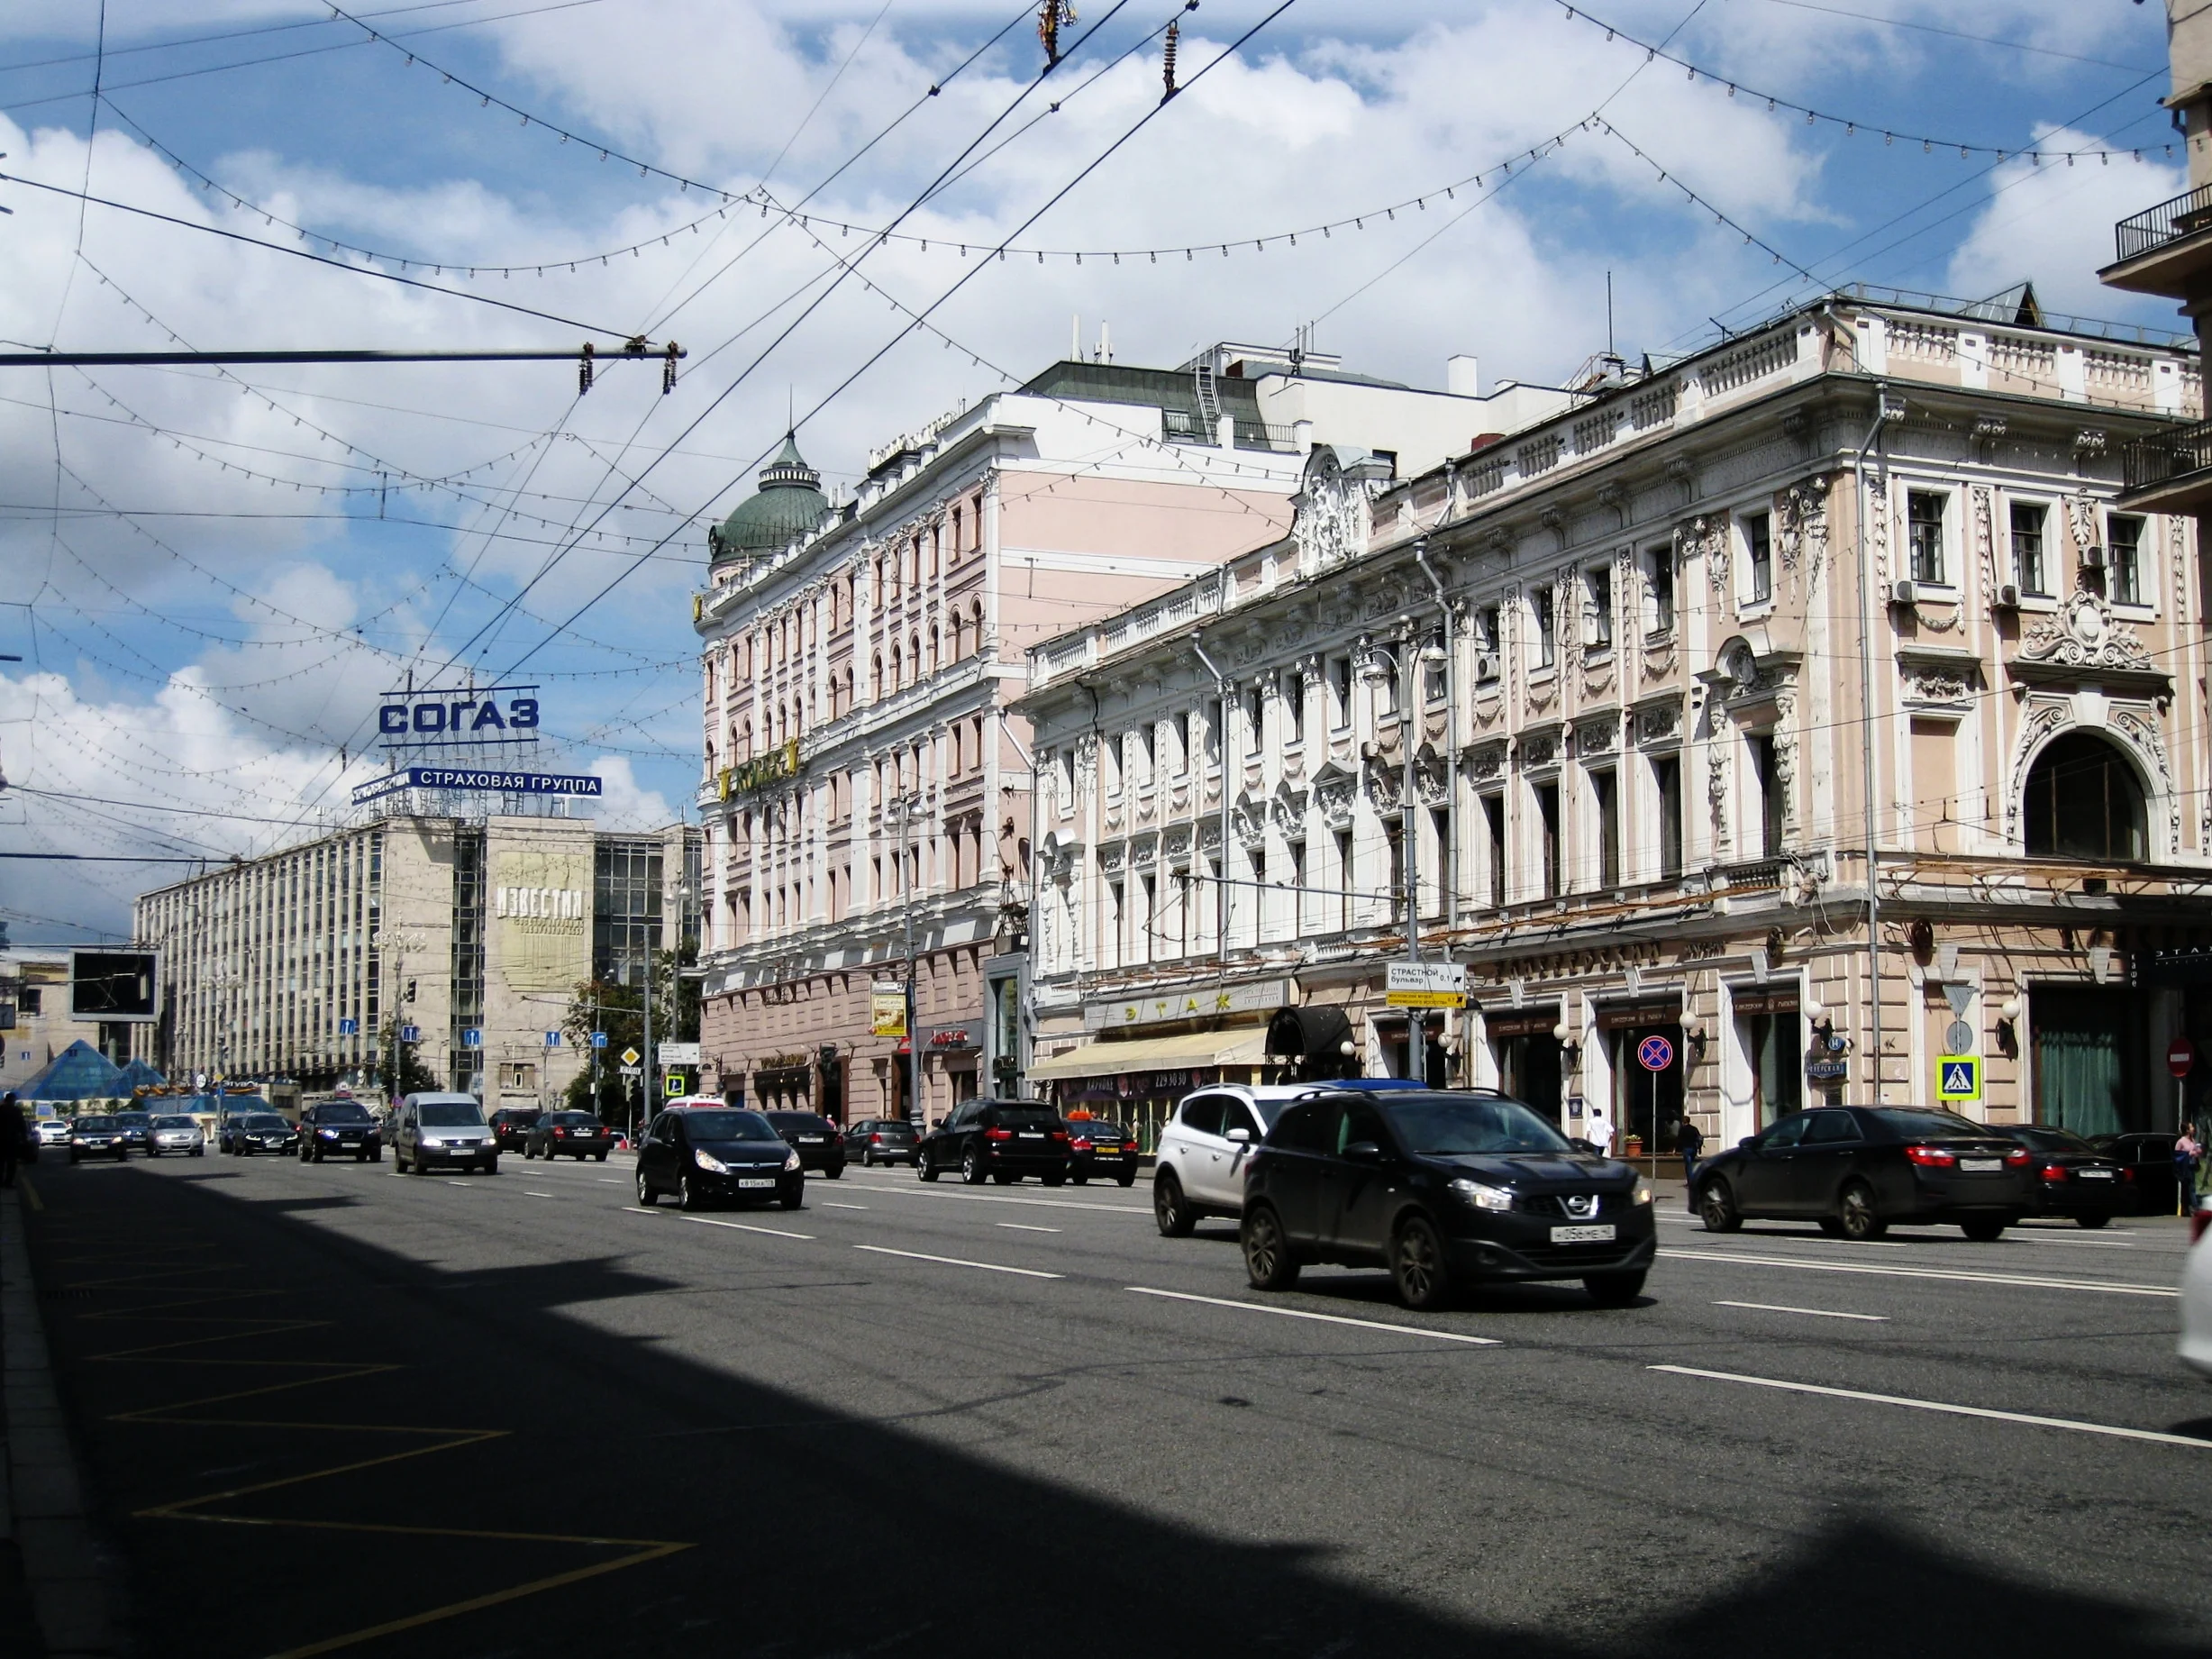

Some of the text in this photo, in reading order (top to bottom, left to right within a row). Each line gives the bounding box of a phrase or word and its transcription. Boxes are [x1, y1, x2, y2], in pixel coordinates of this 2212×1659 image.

[379, 698, 539, 734] СОГАЗ
[420, 771, 524, 788] СТРАХОВАЯ
[531, 777, 598, 792] ГРУППА
[496, 887, 582, 919] ИЗВЕСТИЯ
[1391, 968, 1439, 977] СТРАСТНОЙ
[1391, 976, 1424, 984] бульвар
[1124, 993, 1232, 1021] ЭТАЖ
